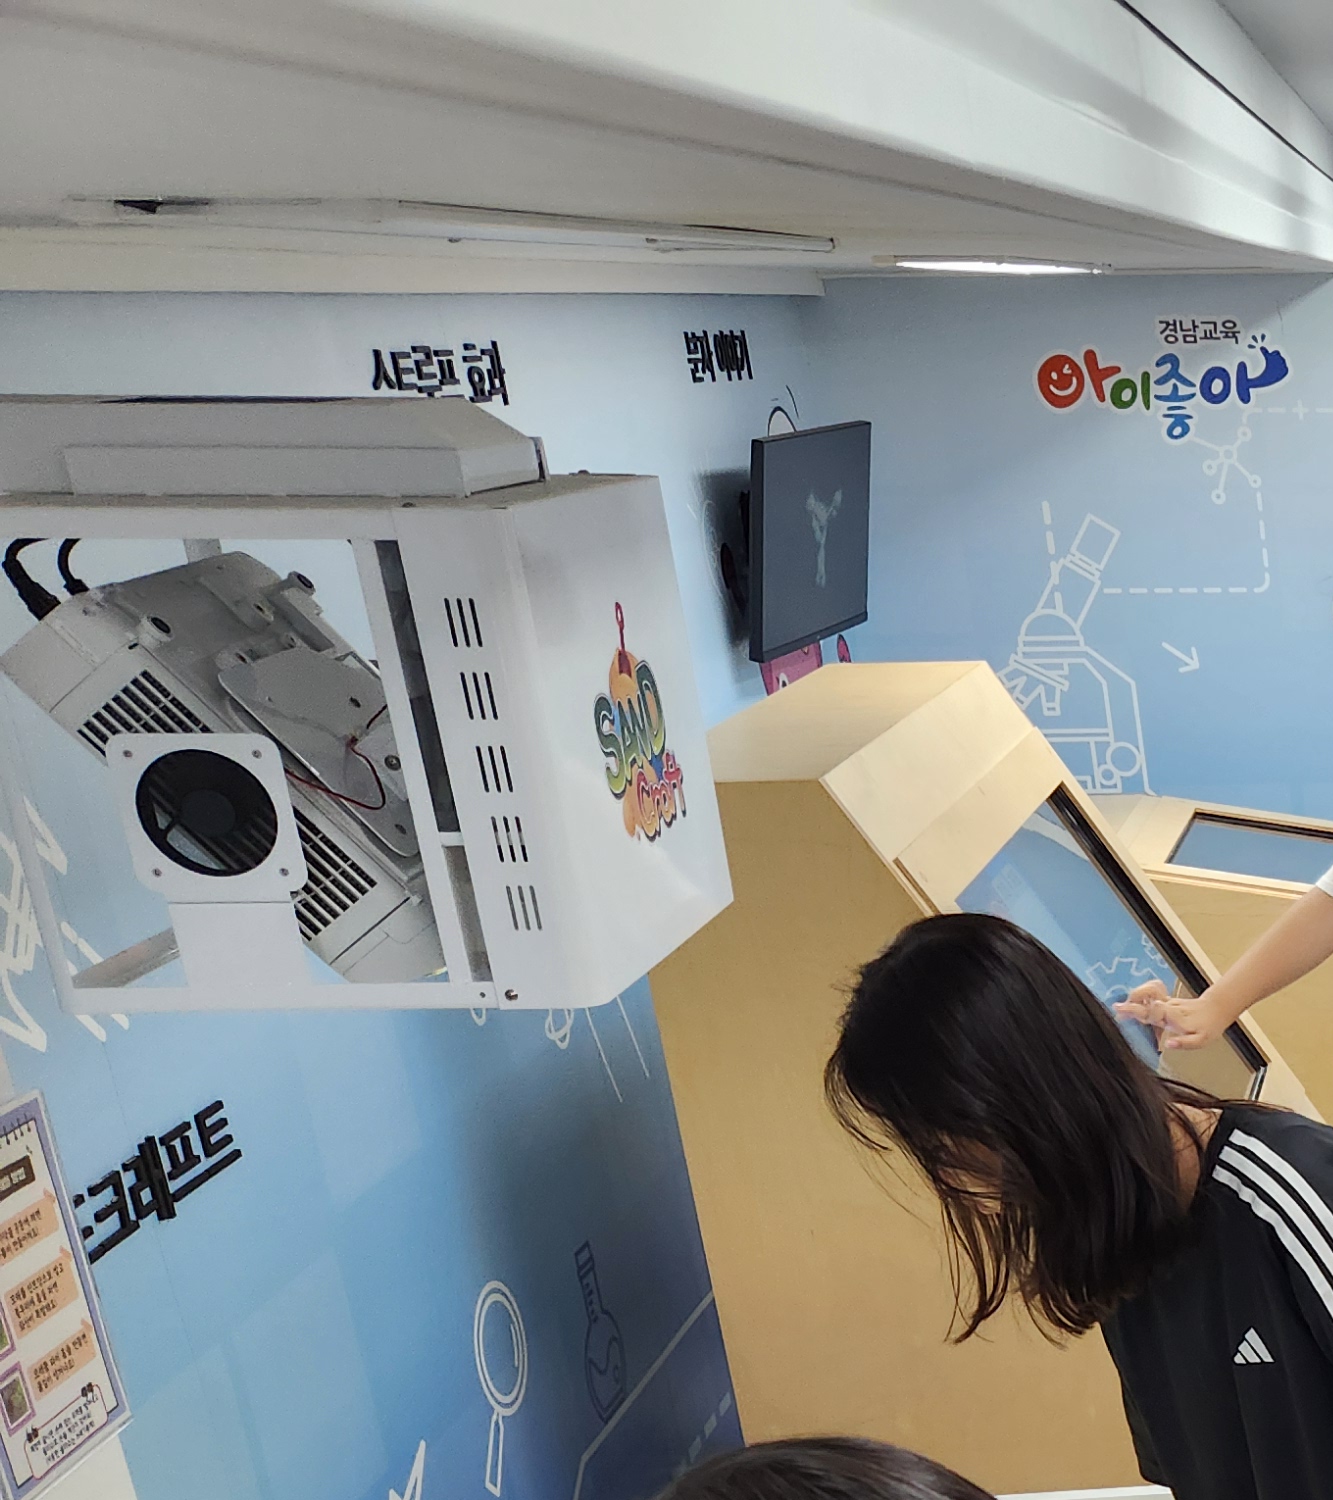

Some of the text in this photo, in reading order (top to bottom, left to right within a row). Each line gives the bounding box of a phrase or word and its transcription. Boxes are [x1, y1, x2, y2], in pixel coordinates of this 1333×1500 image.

[683, 329, 754, 383] 분자 이야기
[1159, 319, 1241, 345] 경남교육
[1037, 348, 1290, 441] 아이좋아
[594, 660, 668, 800] SAND
